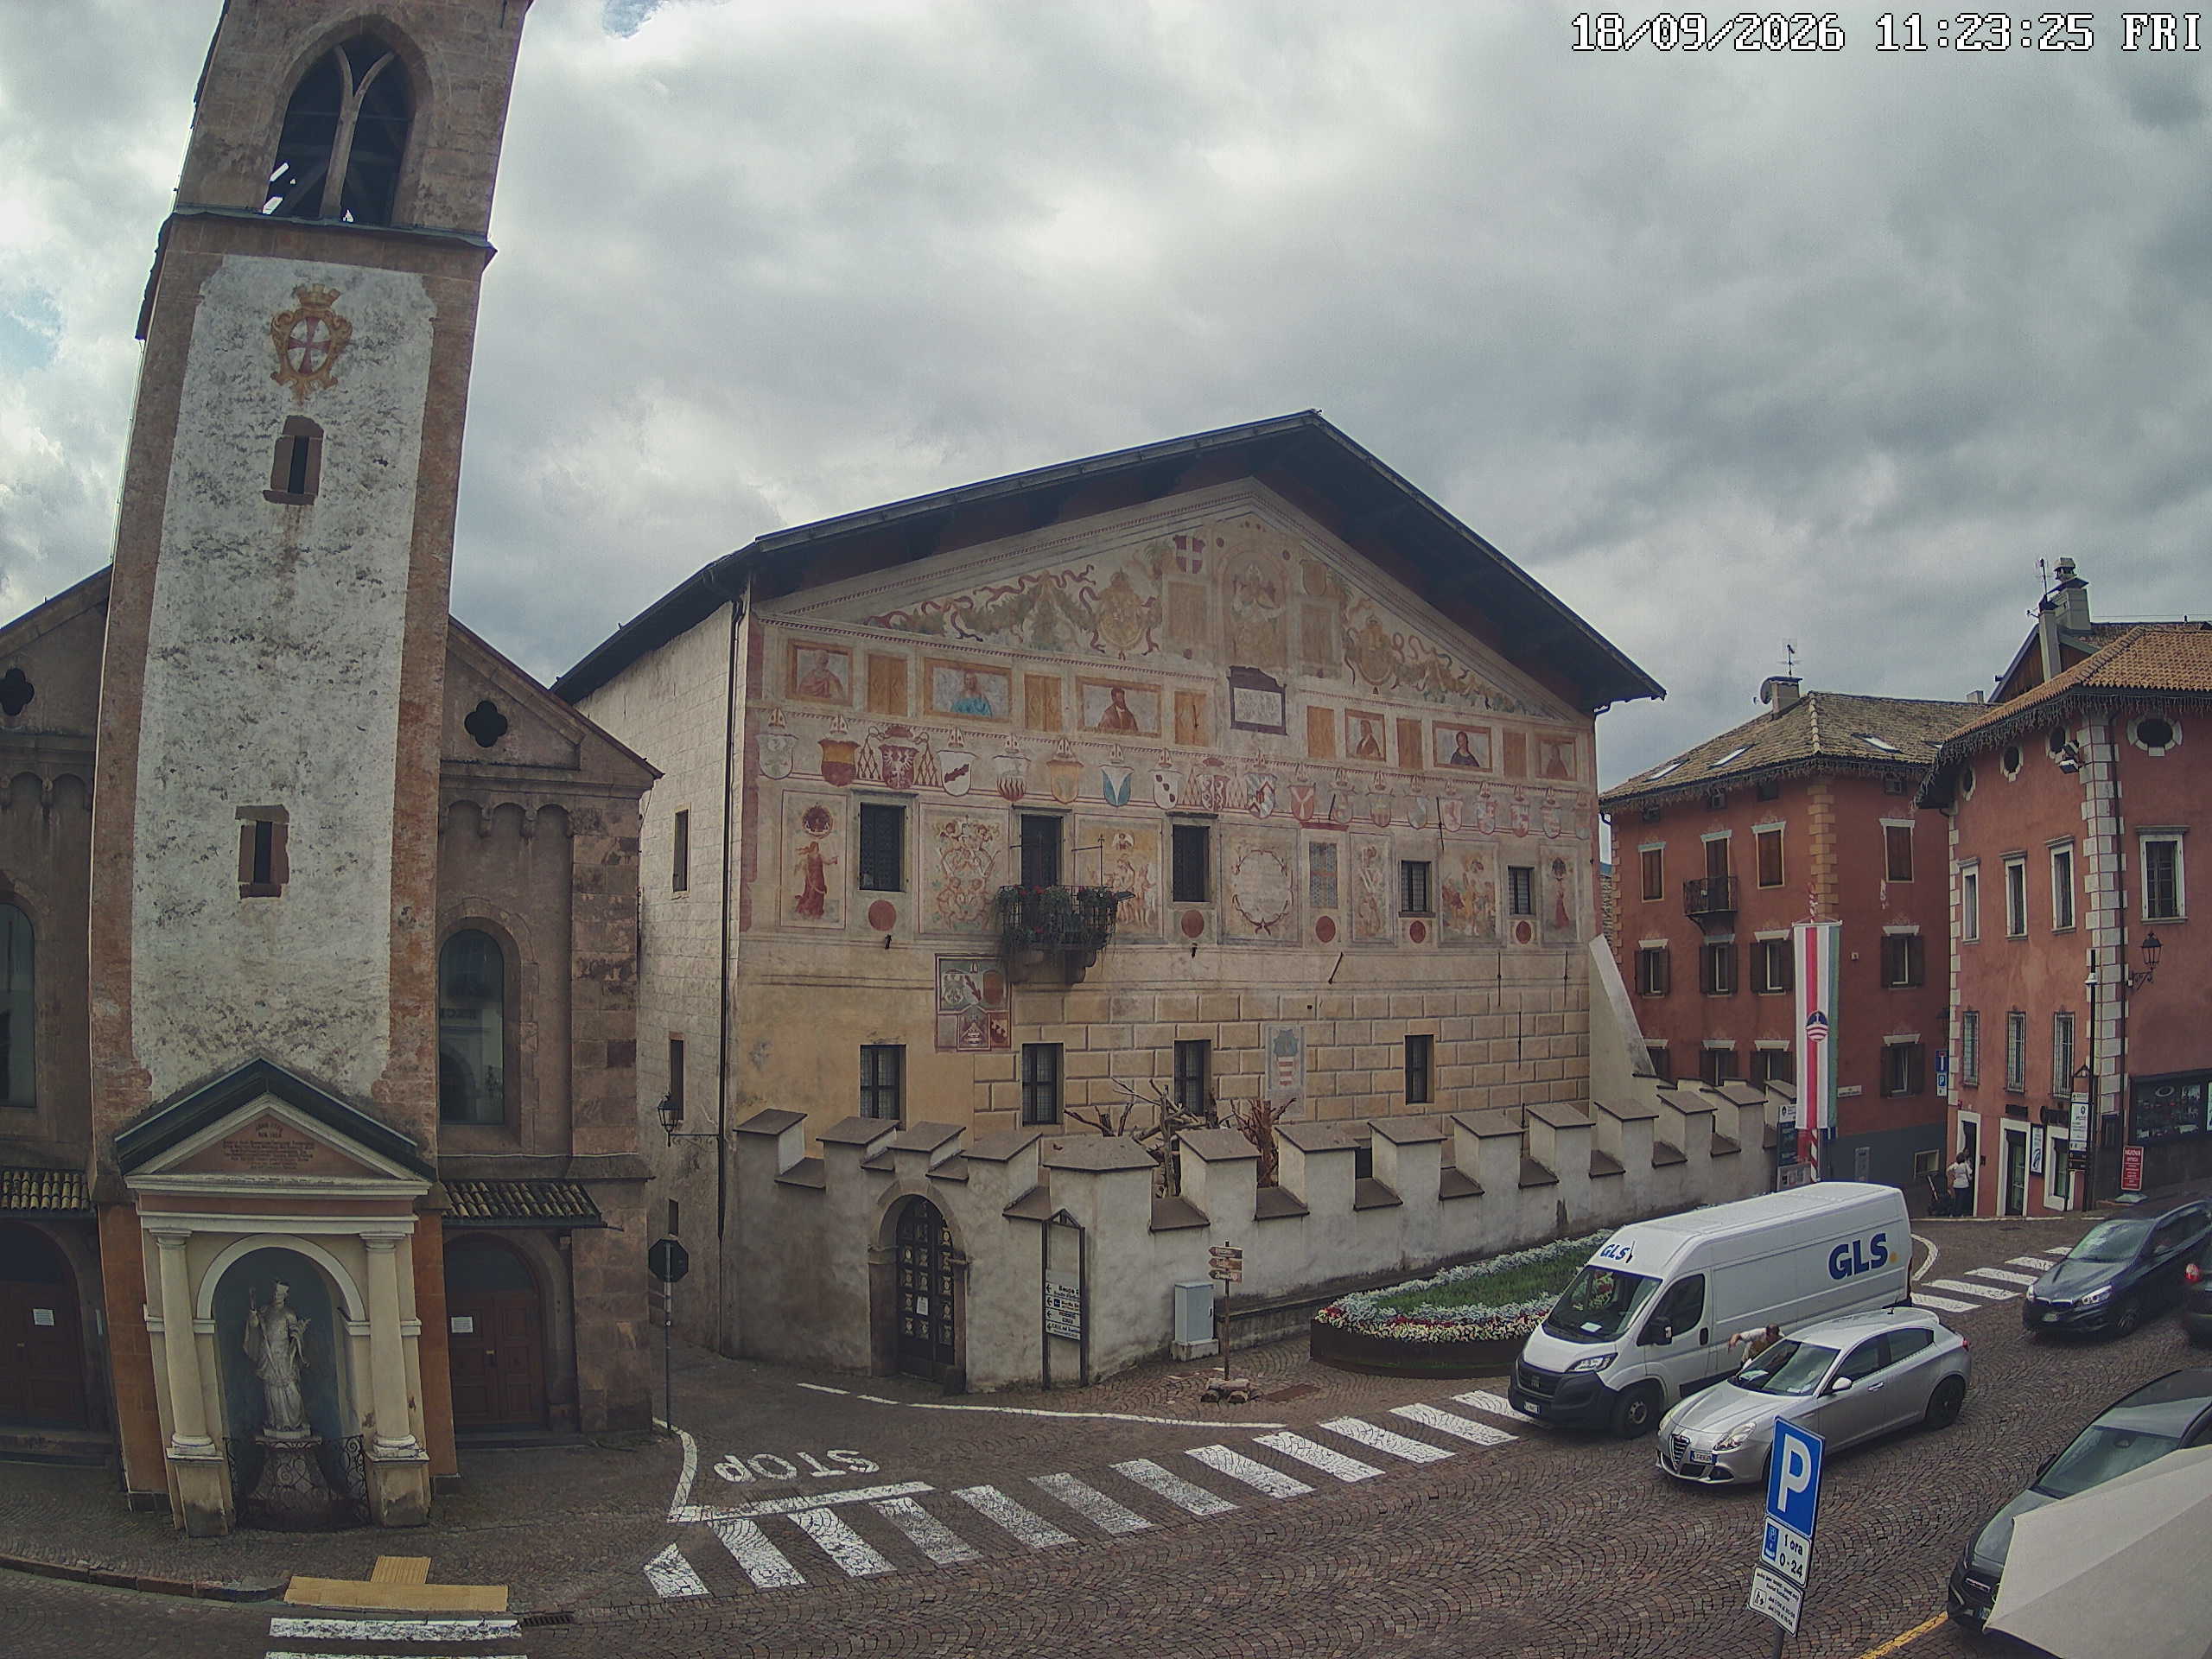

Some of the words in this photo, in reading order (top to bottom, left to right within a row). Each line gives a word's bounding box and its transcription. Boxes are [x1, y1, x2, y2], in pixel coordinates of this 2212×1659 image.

[1600, 1244, 1630, 1260] GLS
[1828, 1233, 1888, 1280] GLS
[714, 1449, 880, 1483] STOP
[1777, 1433, 1812, 1513] P
[1783, 1534, 1789, 1547] 1
[1789, 1541, 1803, 1556] ora
